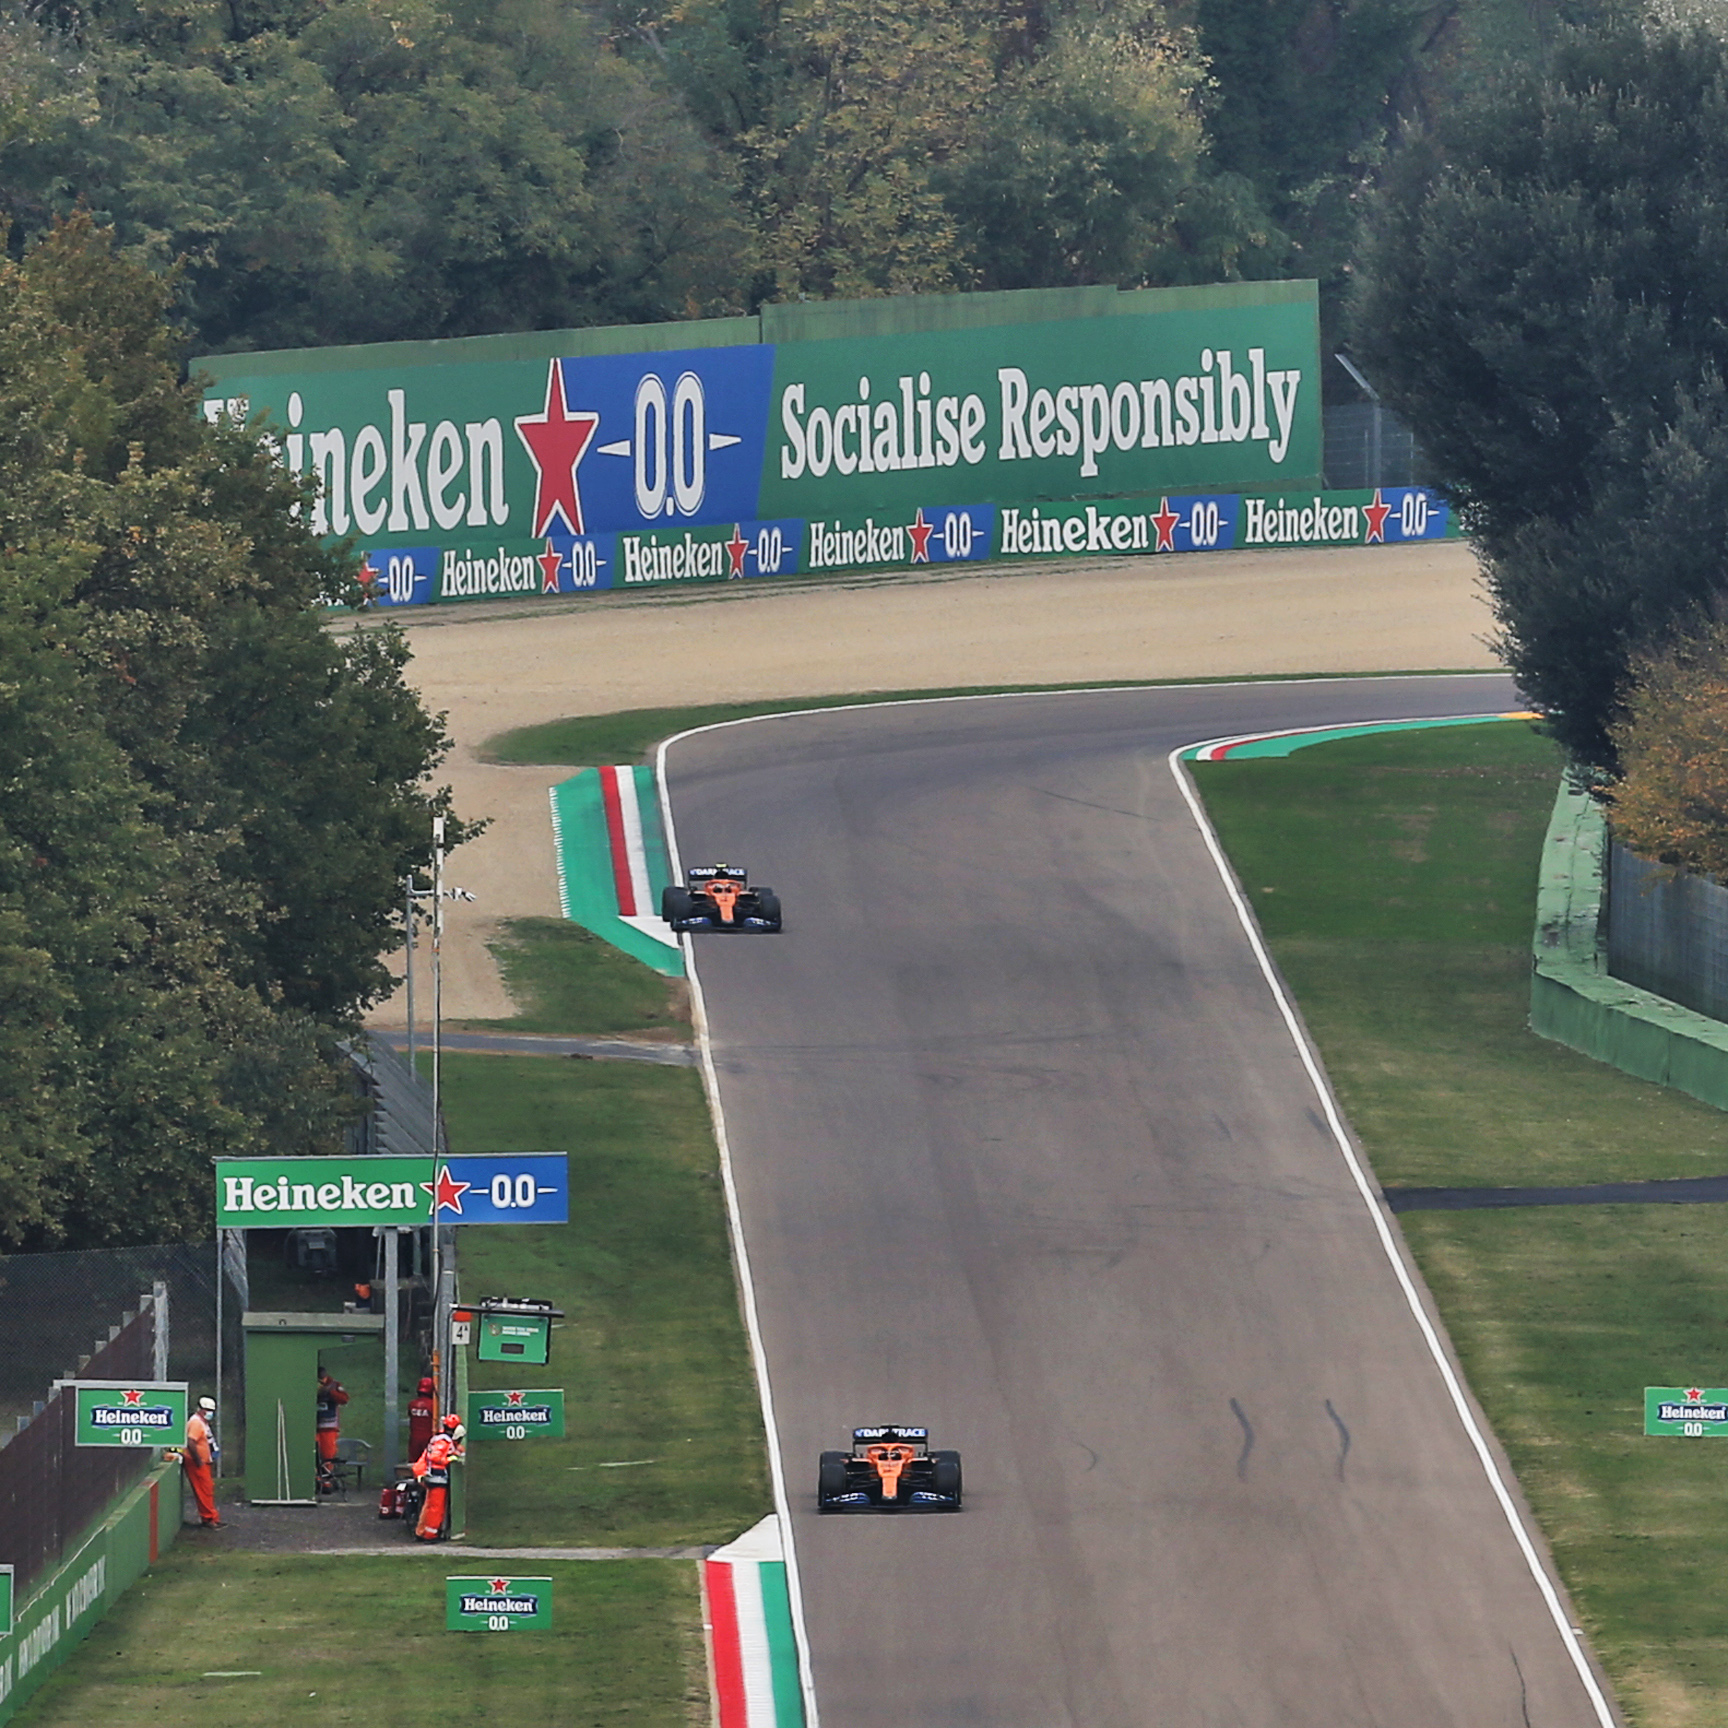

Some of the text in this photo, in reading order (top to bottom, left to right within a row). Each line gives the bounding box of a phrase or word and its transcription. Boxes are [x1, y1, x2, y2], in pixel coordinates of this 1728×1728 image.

[781, 348, 1302, 479] Socialise Responsibly
[203, 371, 705, 536] ineken 0.0
[809, 512, 972, 568] Heineken 0.0
[1000, 501, 1218, 553] Heineken 0.0
[1244, 497, 1359, 544] Heineken
[1401, 492, 1427, 536] 0.0
[388, 556, 414, 603] 0.0
[440, 541, 596, 597] Heineken 0.0
[623, 527, 782, 583] Heineken 0.0
[223, 1174, 536, 1211] Heineken 0.0
[95, 1409, 168, 1425] Heineken
[483, 1409, 548, 1423] Heineken
[1661, 1405, 1726, 1420] Heineken
[463, 1598, 533, 1612] Heineken
